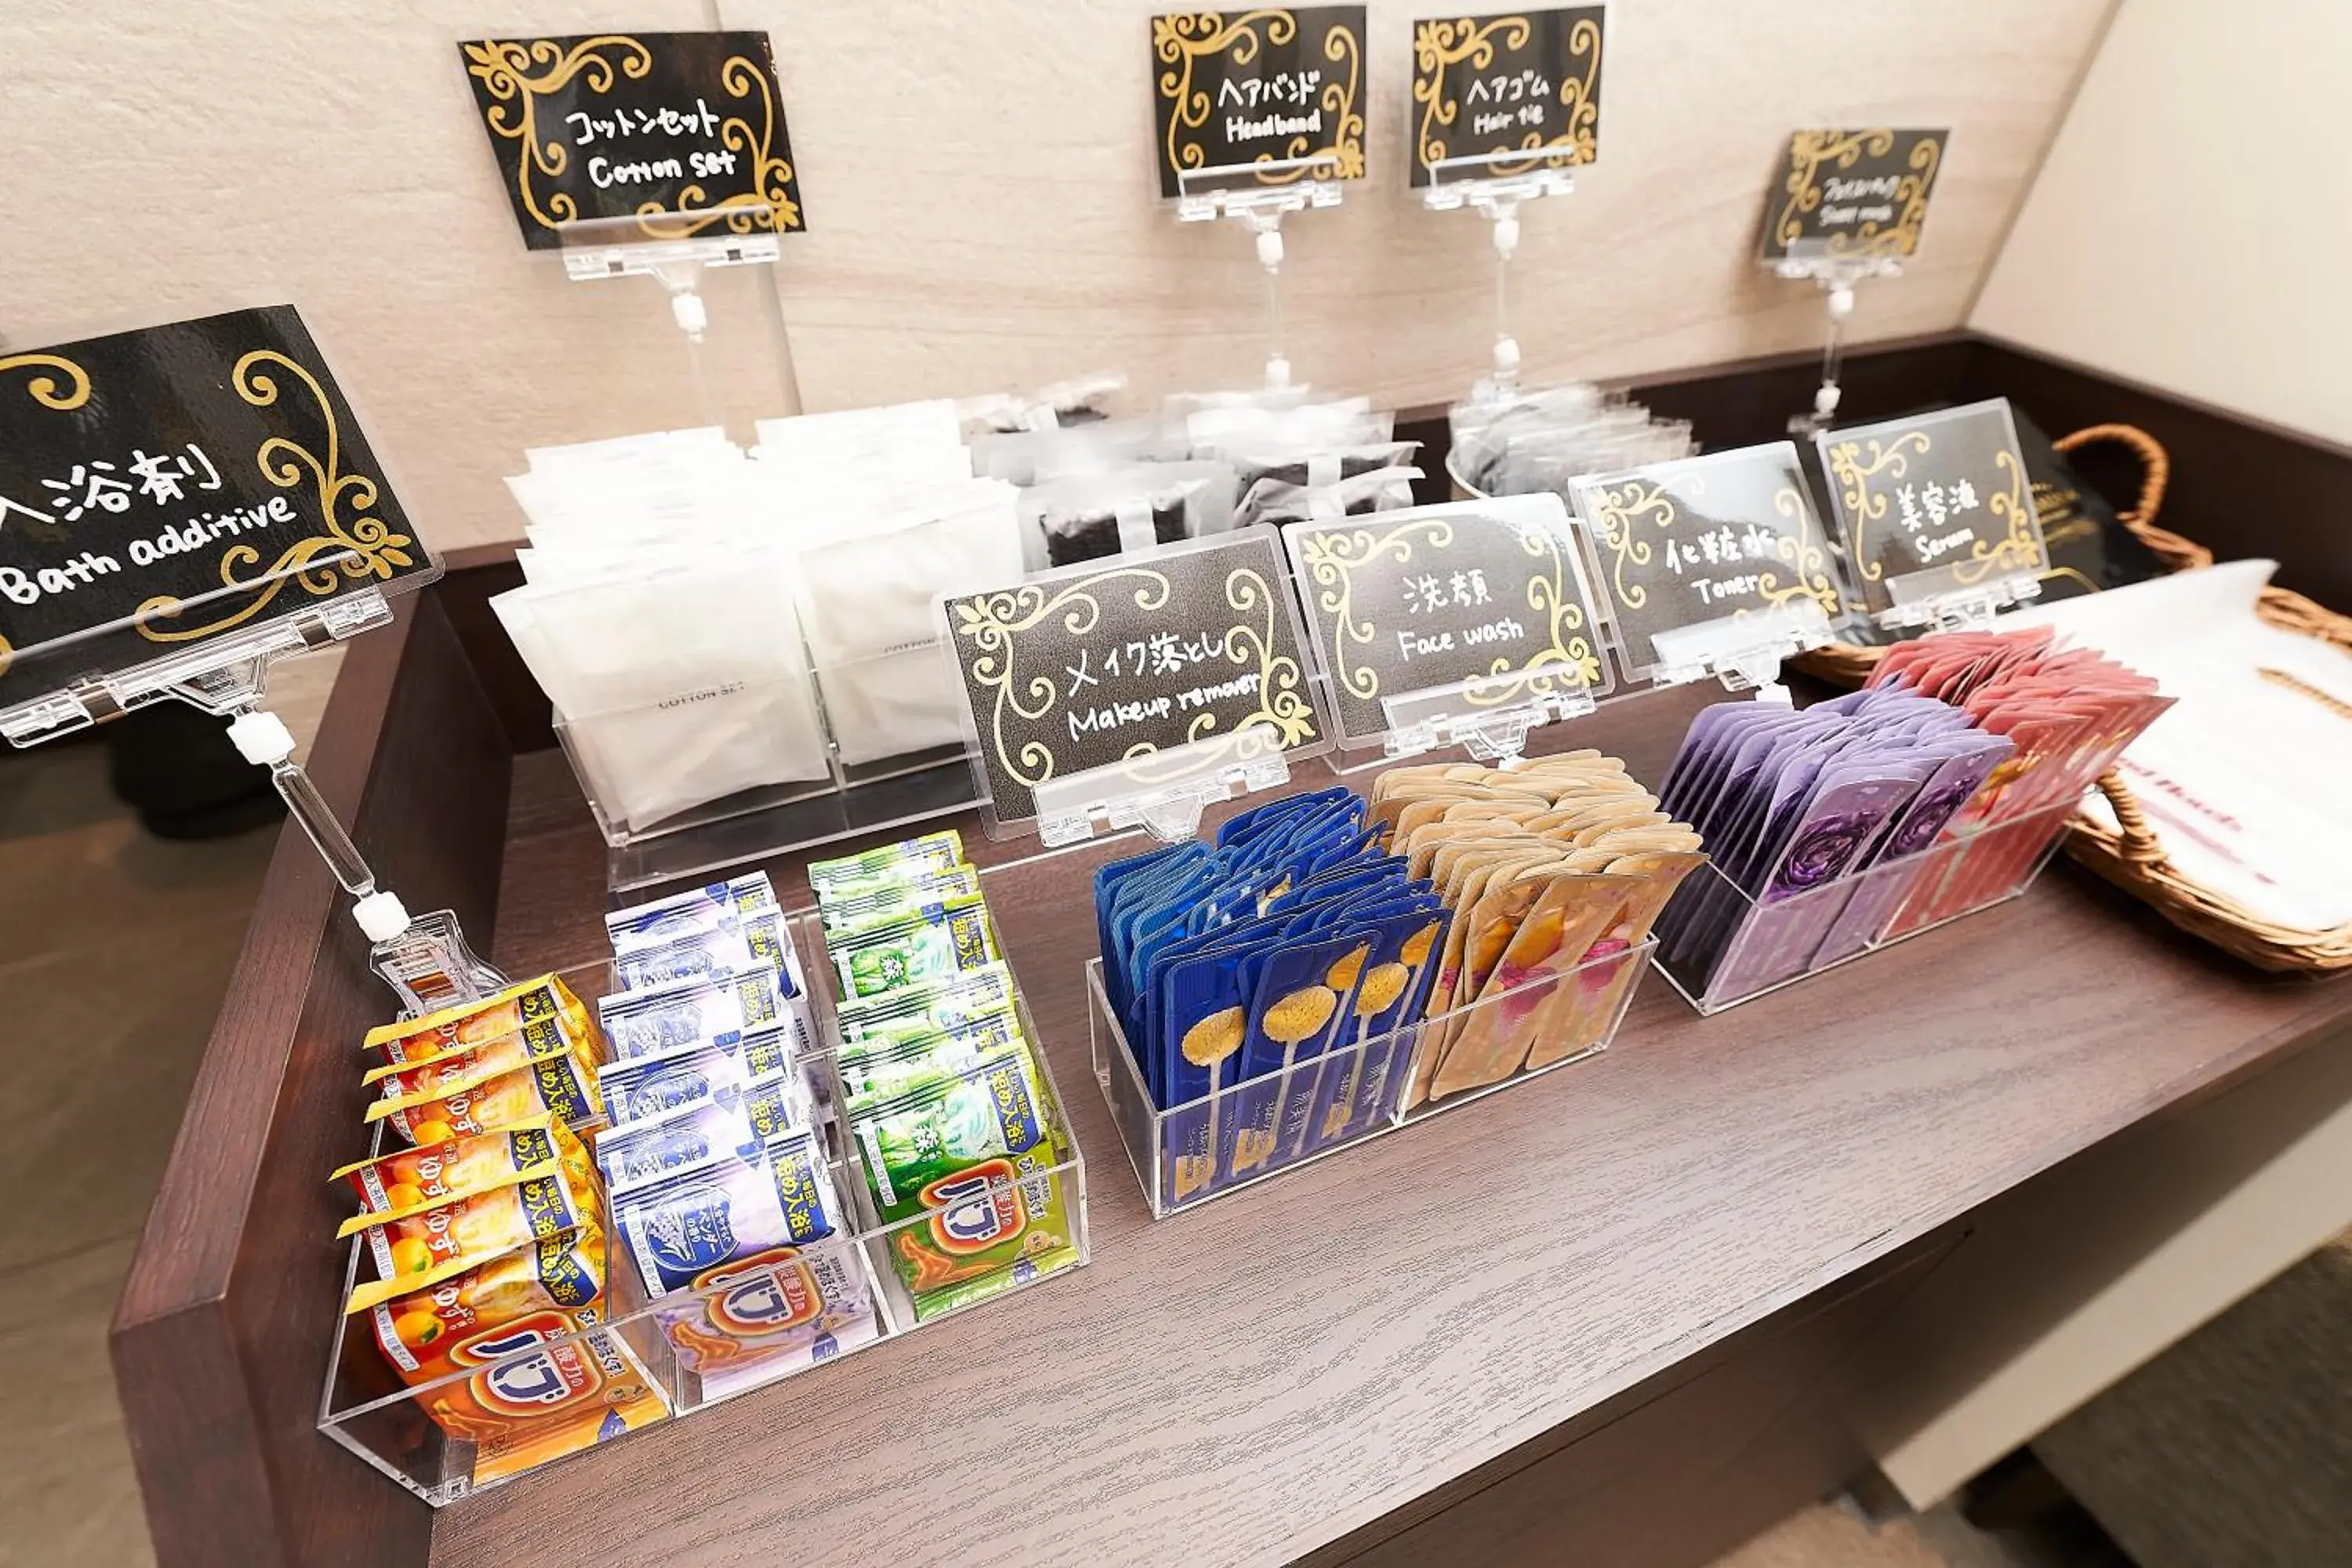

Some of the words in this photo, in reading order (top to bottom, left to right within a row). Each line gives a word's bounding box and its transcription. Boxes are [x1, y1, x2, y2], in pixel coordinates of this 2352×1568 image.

[1218, 71, 1320, 108] ヘアバンド
[1468, 71, 1550, 105] ヘアゴム
[565, 98, 720, 145] コットンセット
[1225, 109, 1323, 143] Headband
[1896, 478, 1979, 532] 美容液
[0, 550, 121, 604] Bath
[129, 495, 296, 567] additive
[1666, 524, 1776, 574] 化粧水
[1915, 528, 1973, 563] Serum
[1403, 569, 1493, 614] 洗顔
[1690, 575, 1759, 604] Toner
[1397, 630, 1455, 661] Face
[1465, 617, 1524, 645] wash
[1066, 631, 1224, 697] メイク落とし
[1068, 696, 1171, 742] Makeup
[1177, 674, 1261, 712] remover
[935, 1178, 1000, 1240] バブ
[470, 1331, 569, 1402] バブ
